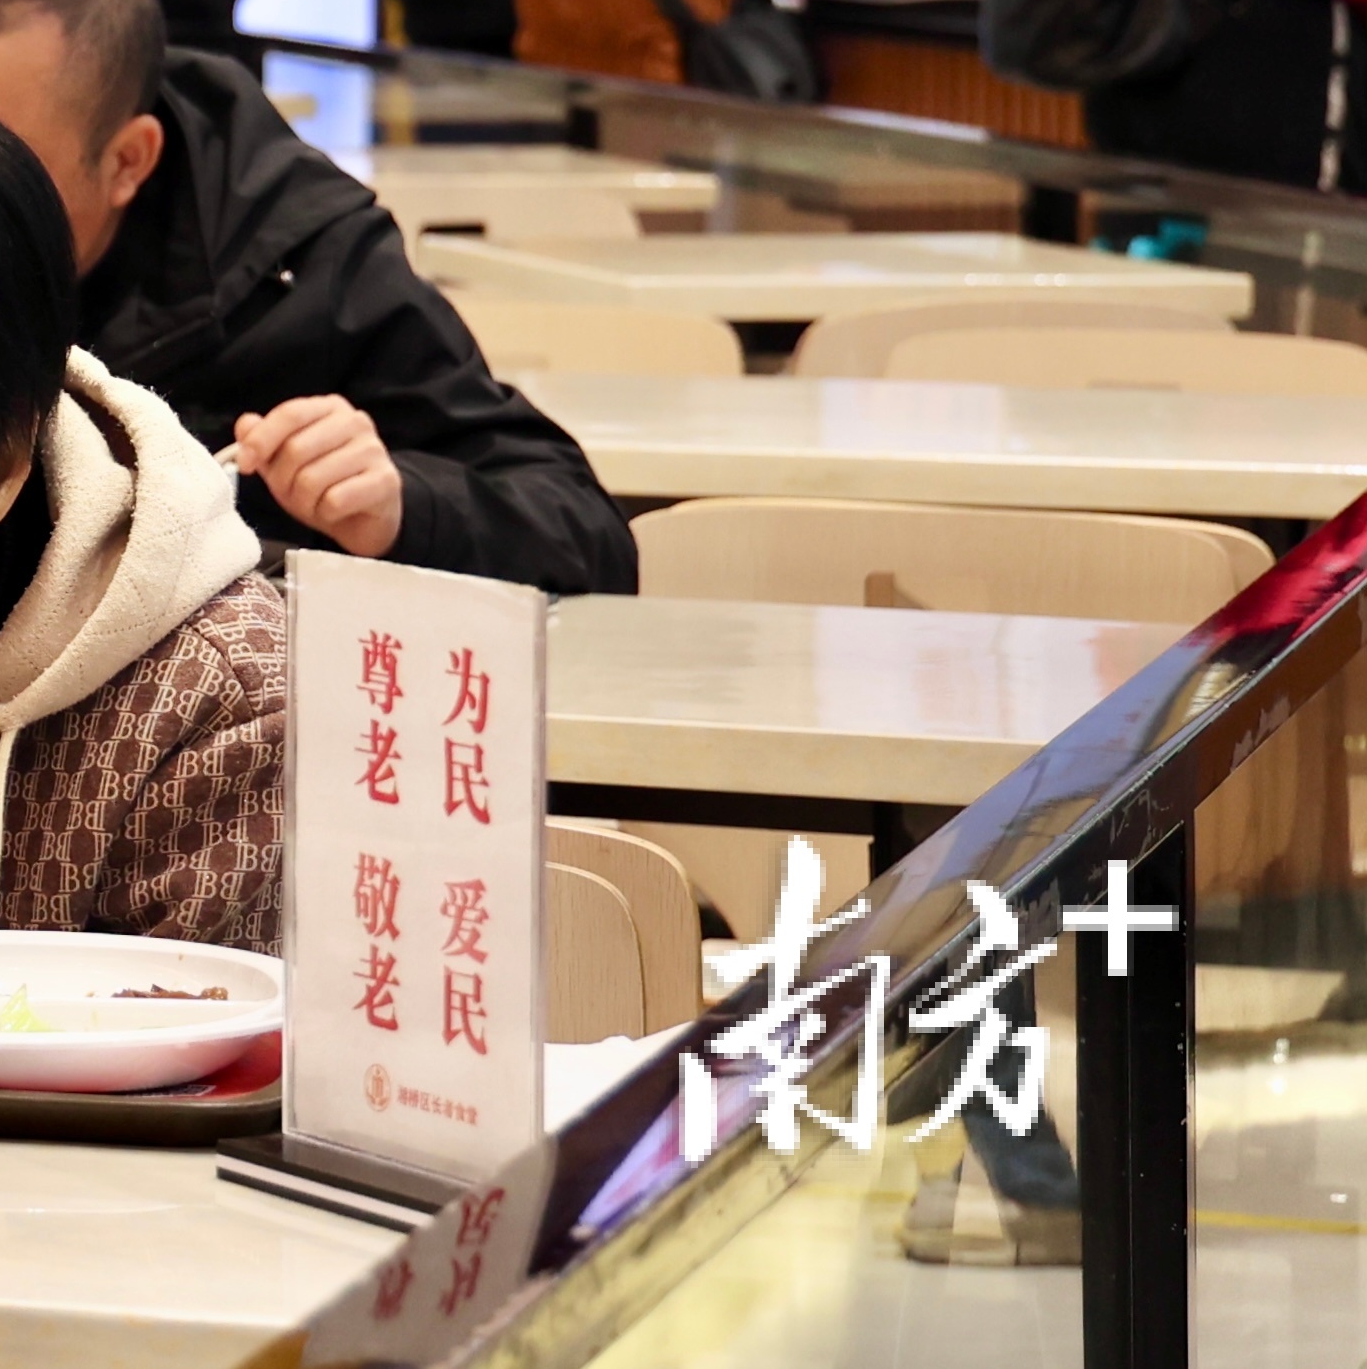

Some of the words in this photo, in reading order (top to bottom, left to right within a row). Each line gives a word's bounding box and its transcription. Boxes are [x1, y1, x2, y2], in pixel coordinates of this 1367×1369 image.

[355, 629, 404, 806] 尊老
[441, 647, 492, 825] 为民
[352, 851, 402, 1032] 敬老
[439, 878, 491, 1056] 爱民
